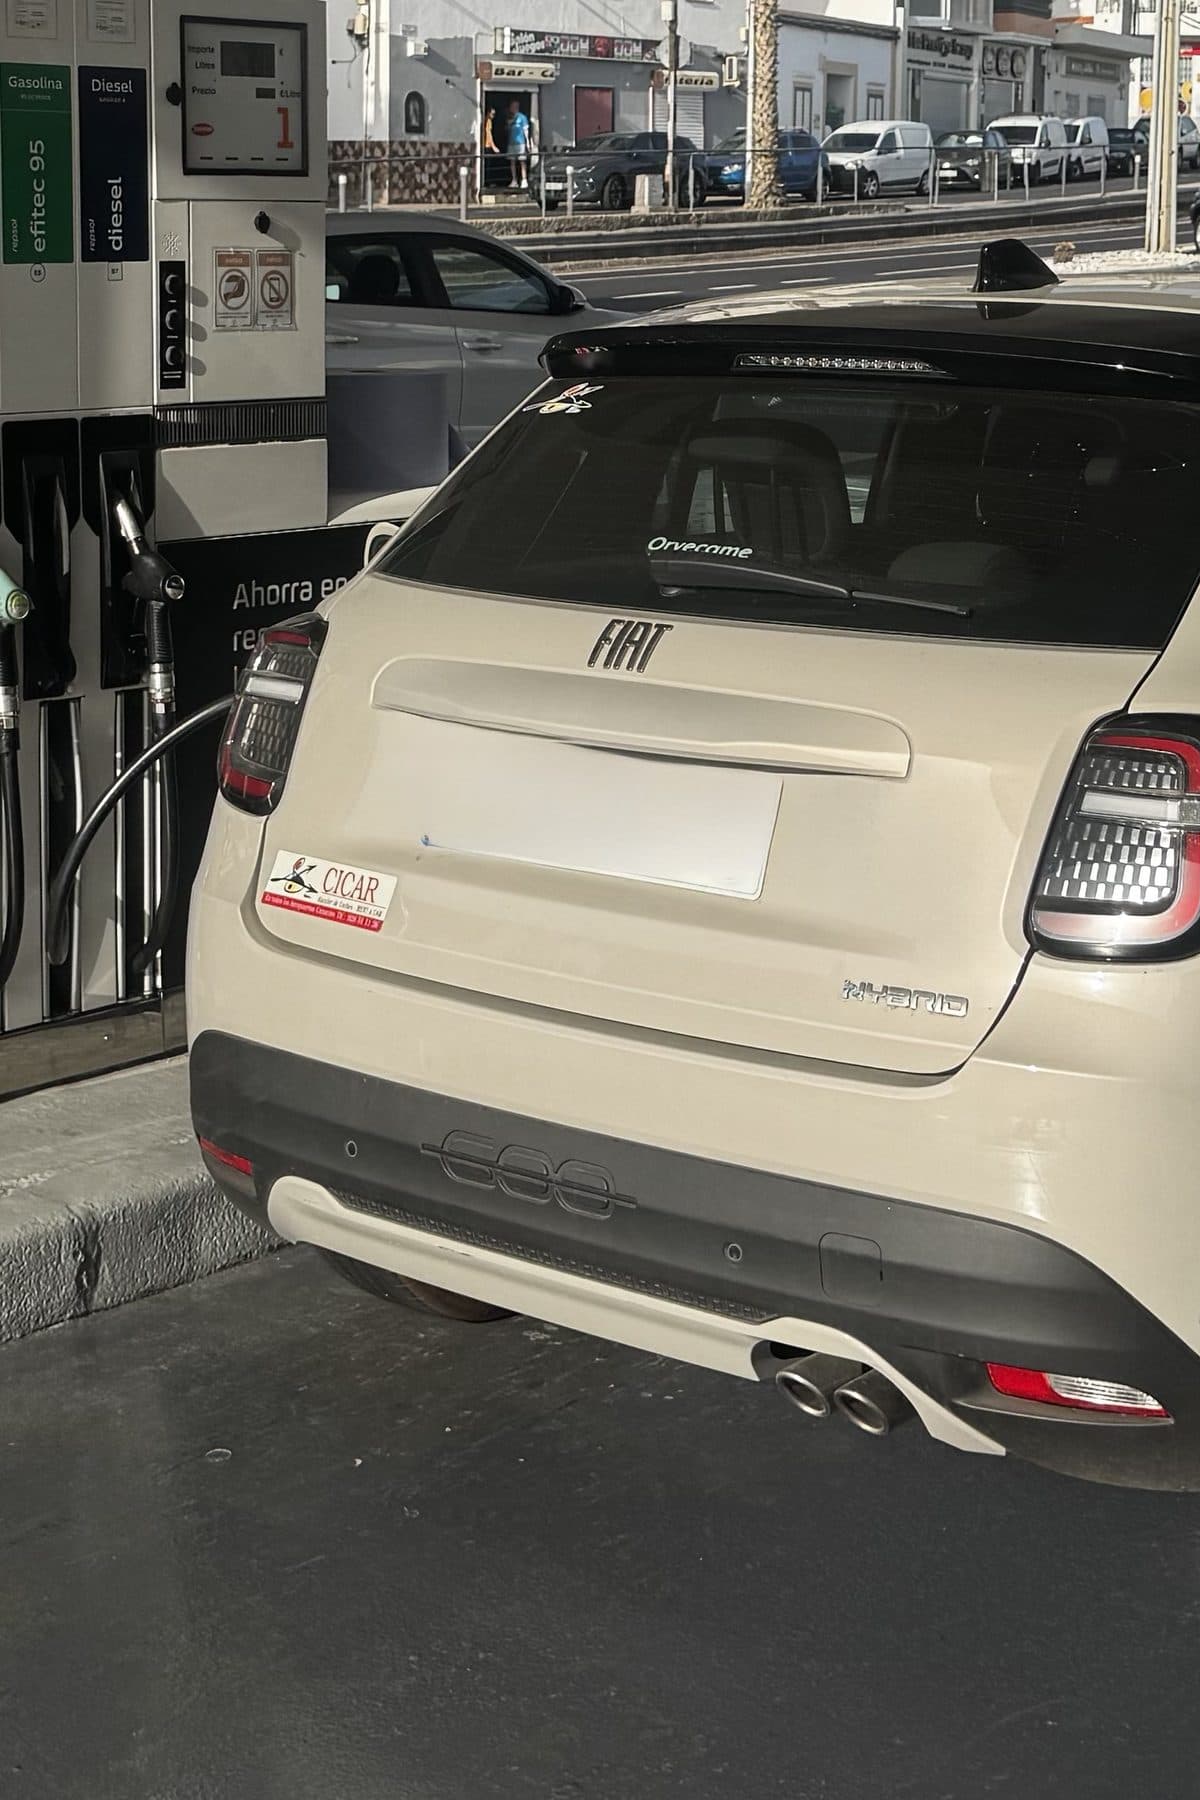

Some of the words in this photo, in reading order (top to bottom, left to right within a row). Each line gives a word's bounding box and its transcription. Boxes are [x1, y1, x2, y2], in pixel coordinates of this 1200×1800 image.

[8, 76, 63, 90] Gasolina
[91, 79, 133, 93] Diesel
[494, 67, 522, 78] Bar
[192, 86, 216, 95] Precio
[277, 106, 294, 149] 1
[29, 139, 45, 171] 95
[30, 178, 46, 252] efitec
[107, 176, 123, 252] diesel
[10, 218, 19, 252] repsol
[87, 218, 97, 252] repsol
[232, 580, 313, 610] Ahorra
[587, 619, 674, 673] FIAT
[322, 867, 379, 903] CICAR
[842, 979, 969, 1018] HYBRID
